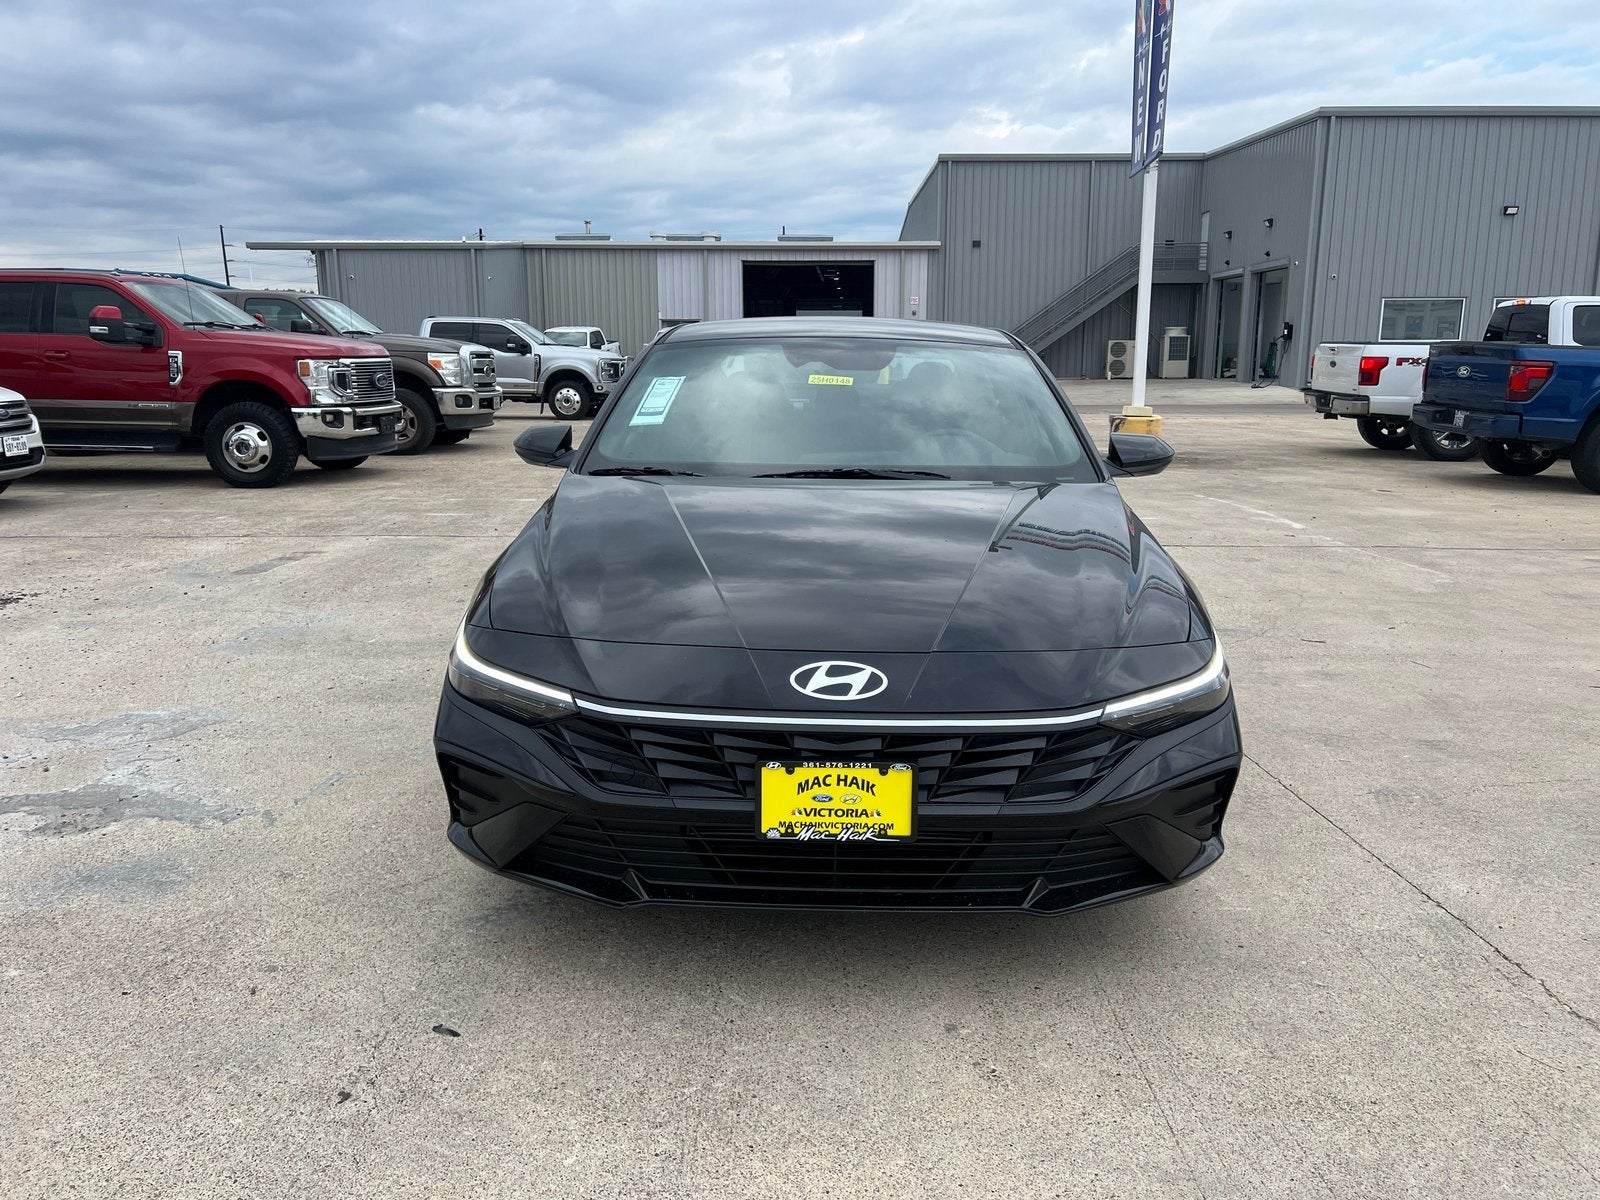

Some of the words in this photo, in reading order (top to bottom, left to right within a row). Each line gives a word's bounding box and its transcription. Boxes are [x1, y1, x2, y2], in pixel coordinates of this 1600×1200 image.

[1152, 37, 1168, 153] FORD
[1134, 57, 1145, 164] NEW
[797, 774, 832, 796] MAC
[836, 774, 877, 797] HAIK
[803, 807, 870, 819] VICTORIA
[797, 826, 836, 842] Mac
[837, 827, 886, 842] Haik
